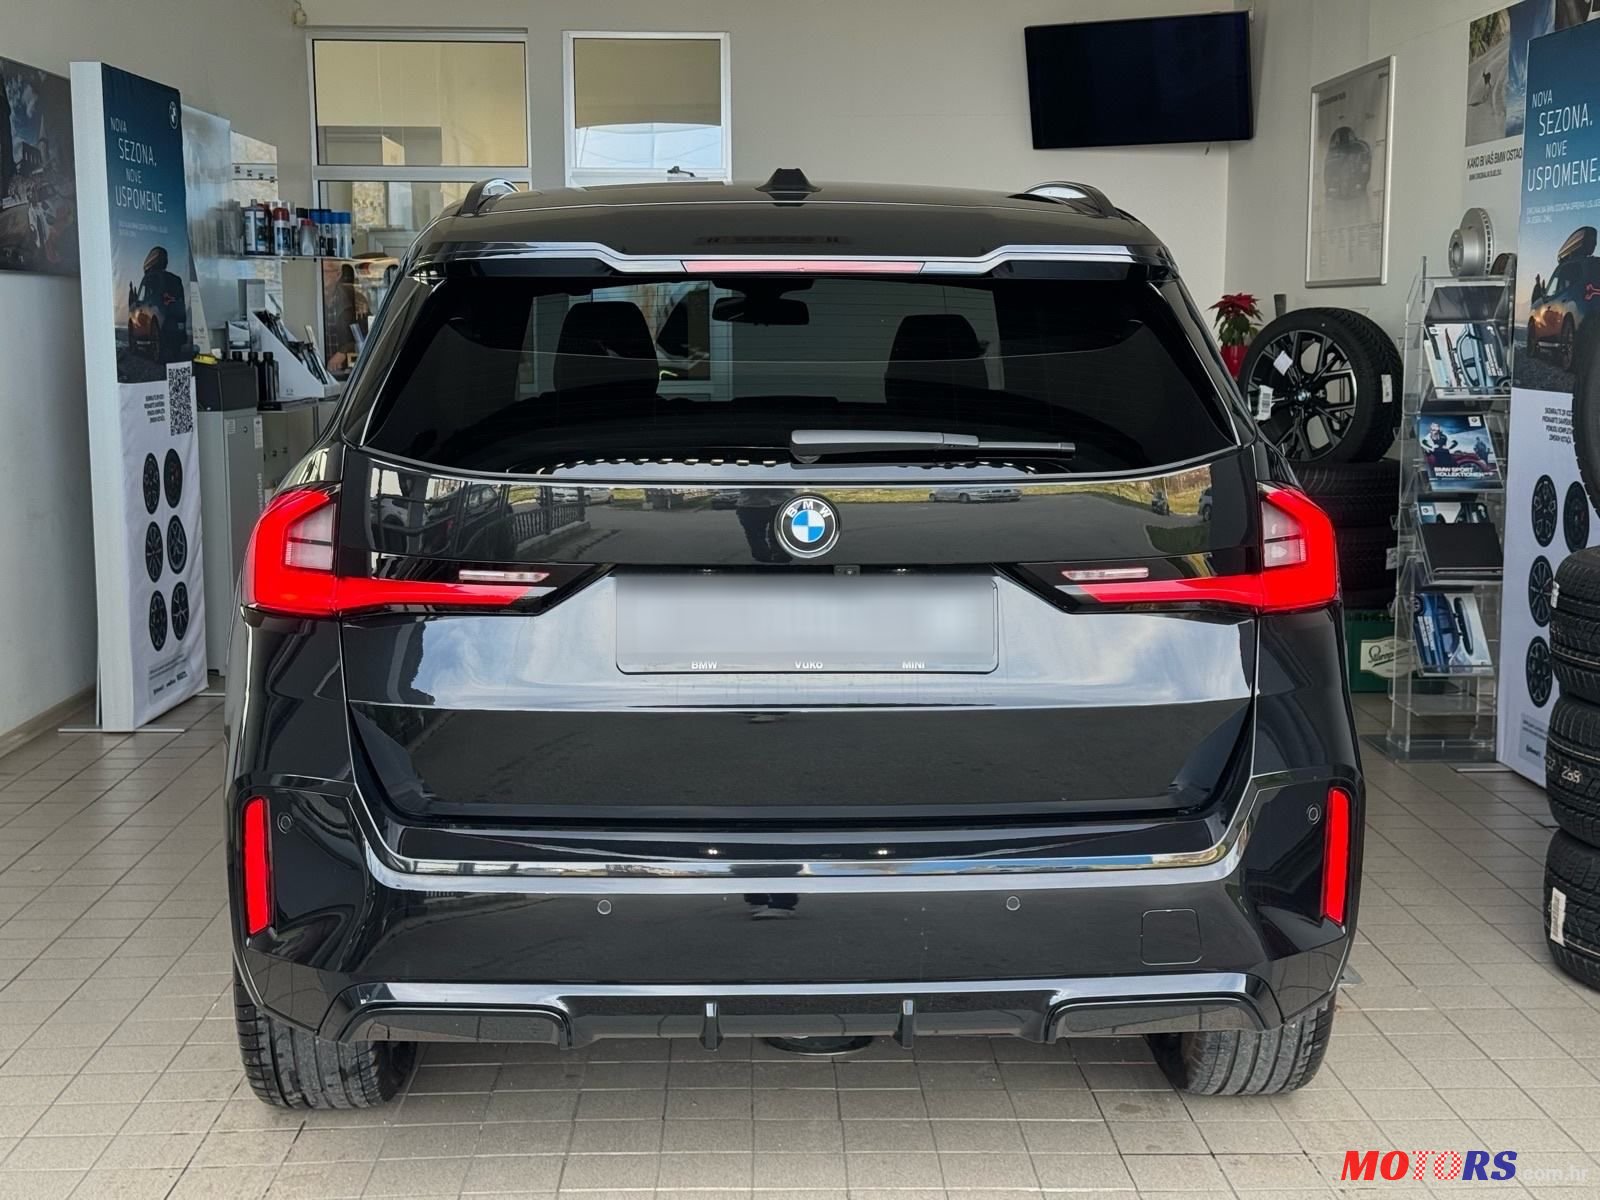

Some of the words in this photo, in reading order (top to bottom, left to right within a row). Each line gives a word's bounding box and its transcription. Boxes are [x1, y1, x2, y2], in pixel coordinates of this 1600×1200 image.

[1532, 89, 1553, 108] NOVA
[110, 116, 127, 133] NOVA
[1538, 103, 1593, 137] SEZONA.
[118, 138, 157, 167] SEZONA.
[1545, 139, 1568, 159] NOVE
[125, 167, 142, 184] NOVE
[115, 187, 167, 213] USPOMENE.
[786, 500, 832, 519] BMW
[691, 660, 718, 670] BMW
[901, 660, 926, 670] MINI
